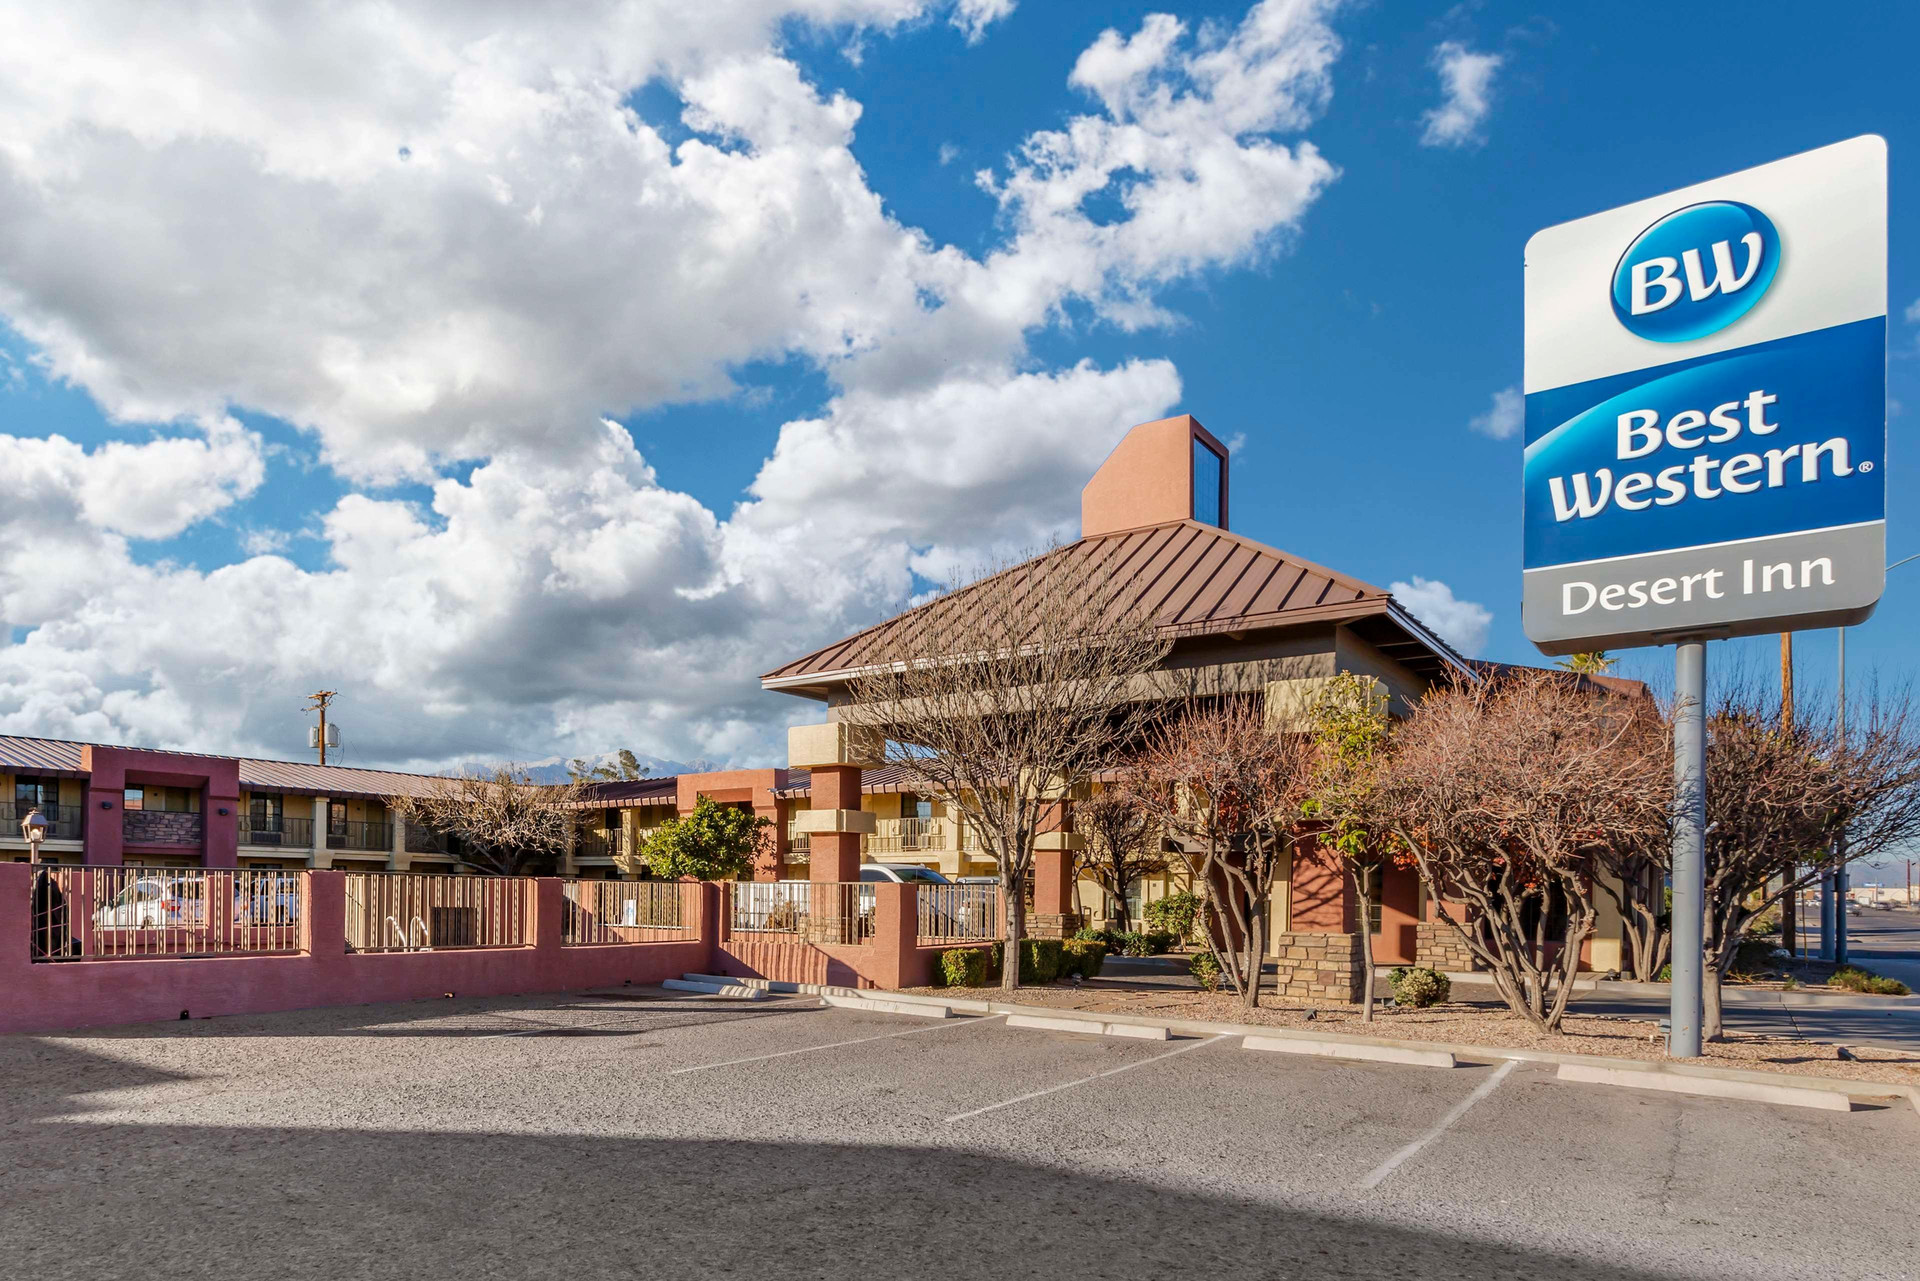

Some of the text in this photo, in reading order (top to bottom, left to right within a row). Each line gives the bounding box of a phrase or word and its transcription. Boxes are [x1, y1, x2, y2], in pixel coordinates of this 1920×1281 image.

[1631, 232, 1762, 315] BW
[1617, 390, 1778, 460] Best
[1562, 557, 1836, 616] Desert Inn
